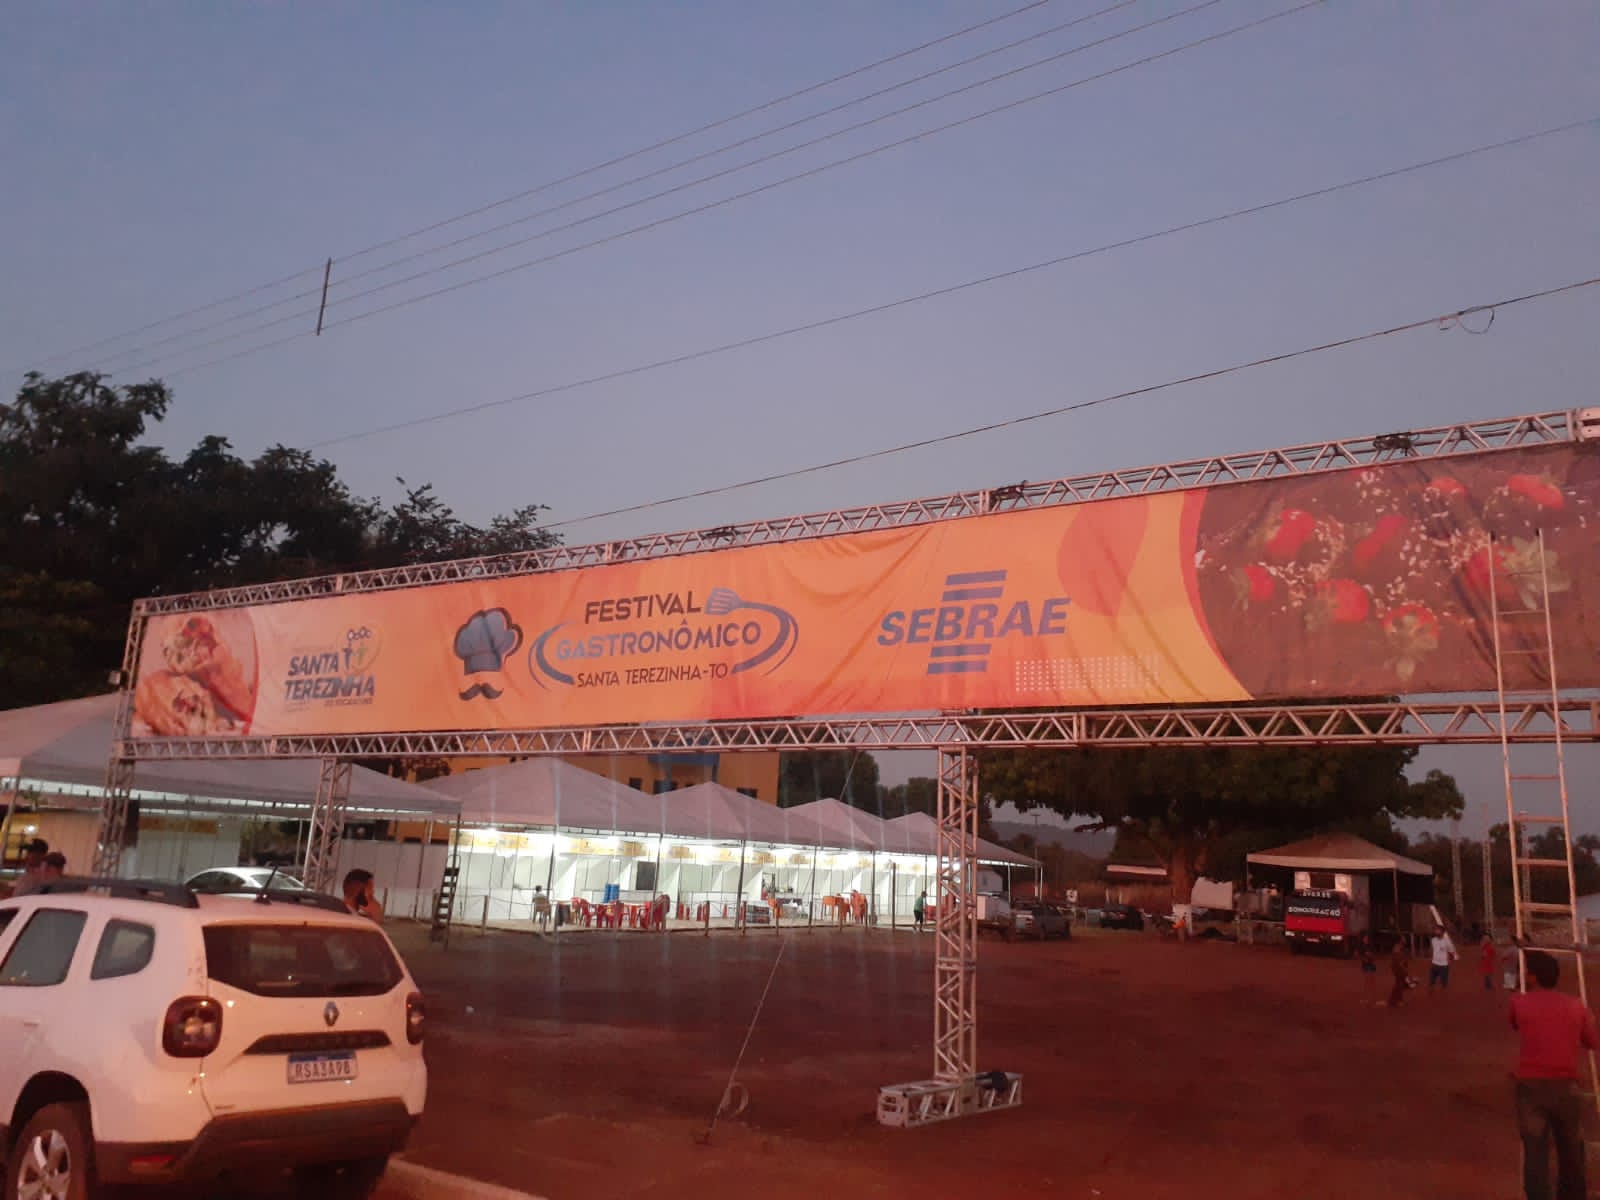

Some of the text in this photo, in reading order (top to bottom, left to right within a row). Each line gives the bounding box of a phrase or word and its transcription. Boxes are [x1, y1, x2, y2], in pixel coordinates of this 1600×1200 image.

[585, 590, 702, 625] FESTIVAL
[876, 597, 1072, 647] SEBRAE
[556, 618, 762, 661] GASTRONÔMICO
[288, 652, 339, 676] SANTA
[577, 662, 729, 688] SANTA TEREZINHA-TO
[284, 676, 375, 701] TEREZINHA
